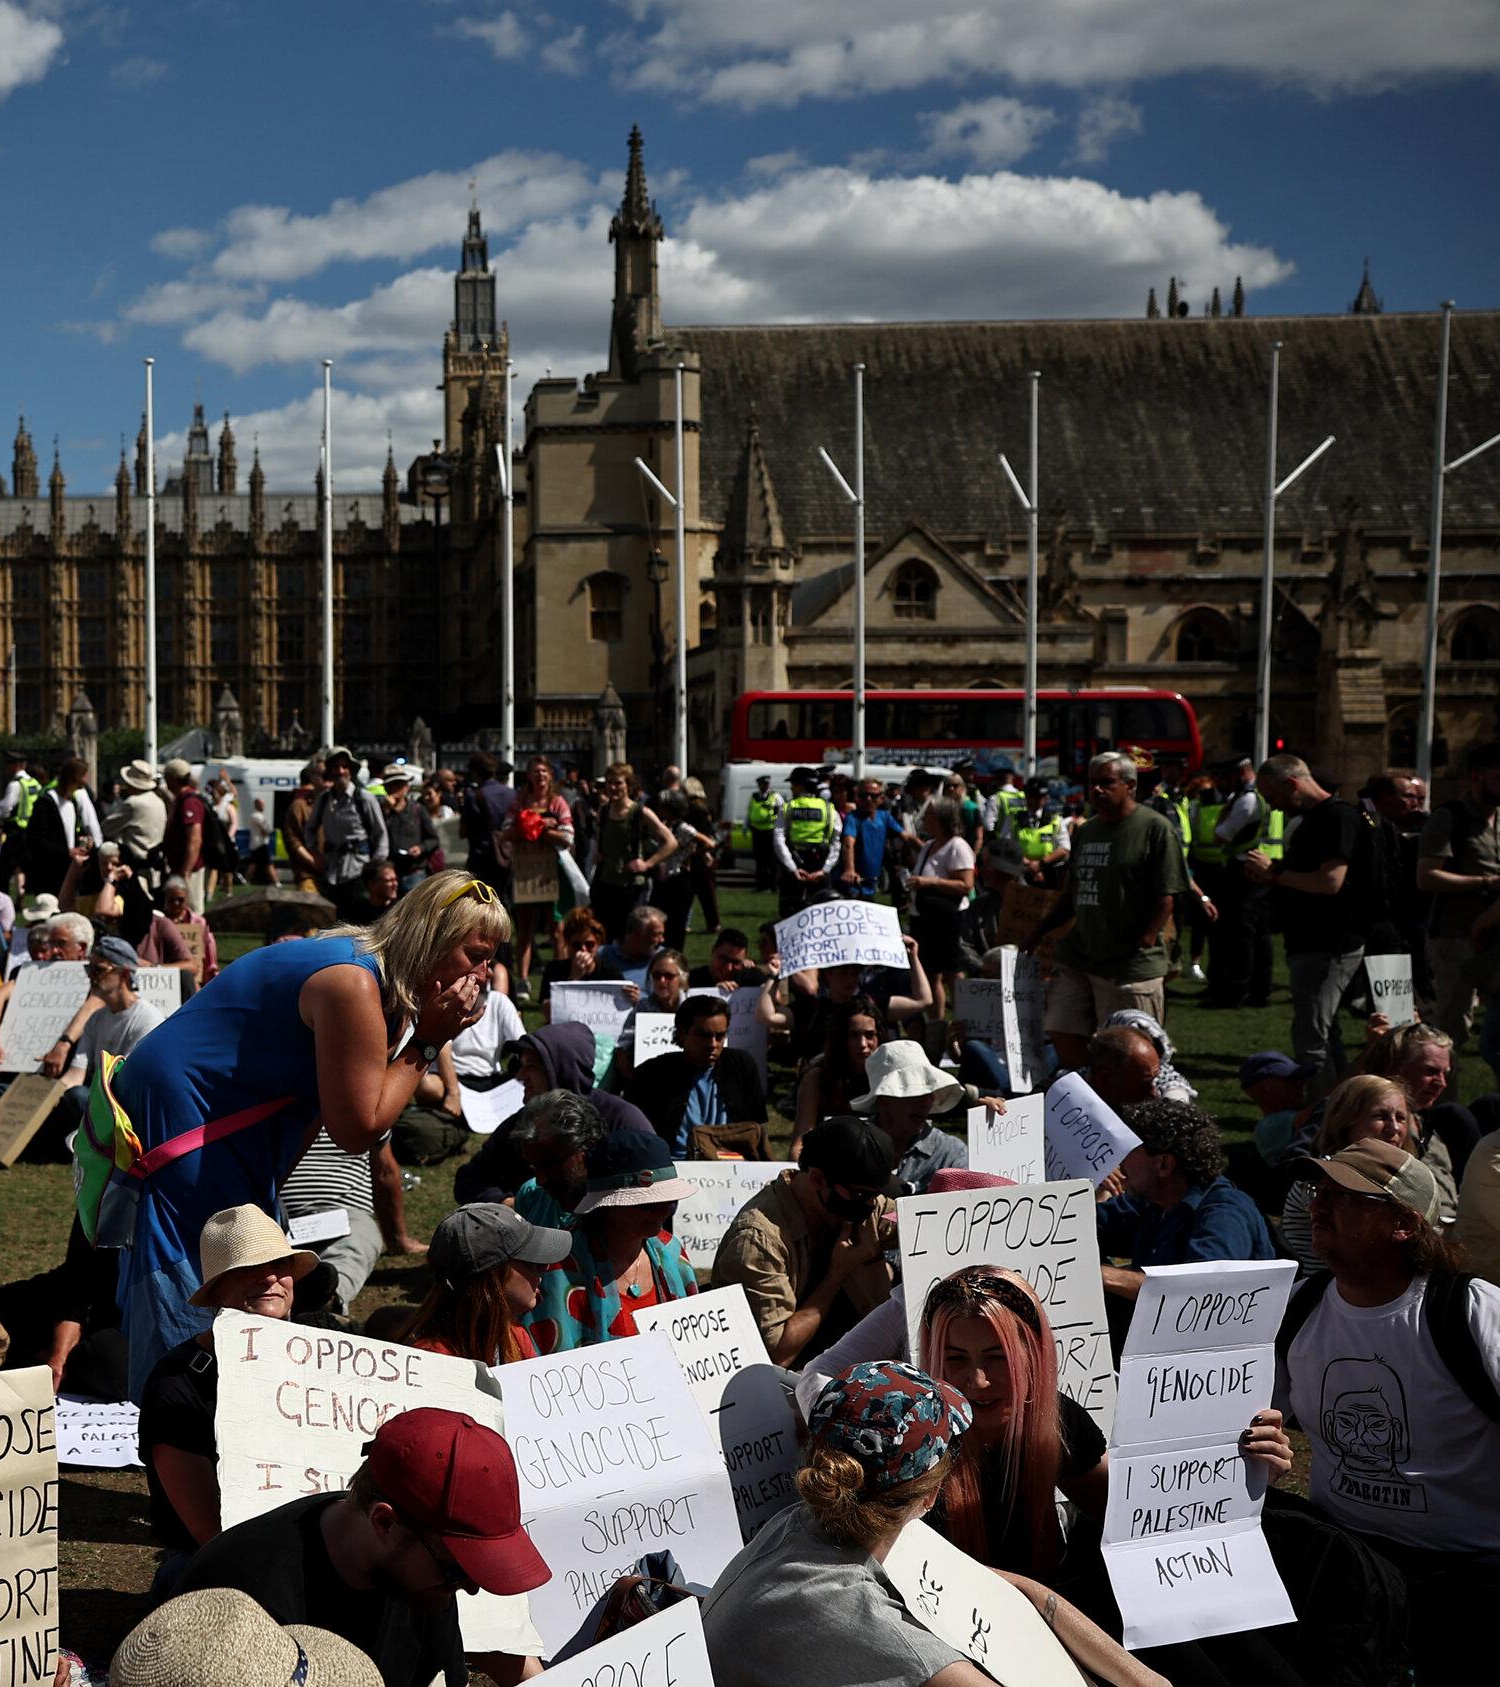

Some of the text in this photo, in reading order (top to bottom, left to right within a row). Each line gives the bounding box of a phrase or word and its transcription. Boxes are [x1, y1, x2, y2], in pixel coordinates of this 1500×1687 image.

[797, 904, 880, 929] OPPOSE
[855, 948, 905, 964] ACTION
[1060, 1106, 1115, 1172] OPPOSE
[908, 1188, 1090, 1257] I OPPOSE
[671, 1308, 730, 1343] OPPOSE
[1152, 1286, 1271, 1336] I OPPOSE
[238, 1326, 423, 1389] I OPPOSE
[529, 1357, 656, 1419] OPPOSE
[1147, 1360, 1258, 1419] GENOCIDE
[256, 1463, 283, 1491] I
[514, 1416, 682, 1490] GENOCIDE
[1125, 1455, 1247, 1501] I SUPPORT
[581, 1493, 699, 1556] SUPPORT
[1130, 1497, 1233, 1540] PALESTINE
[1154, 1541, 1234, 1589] ACTION
